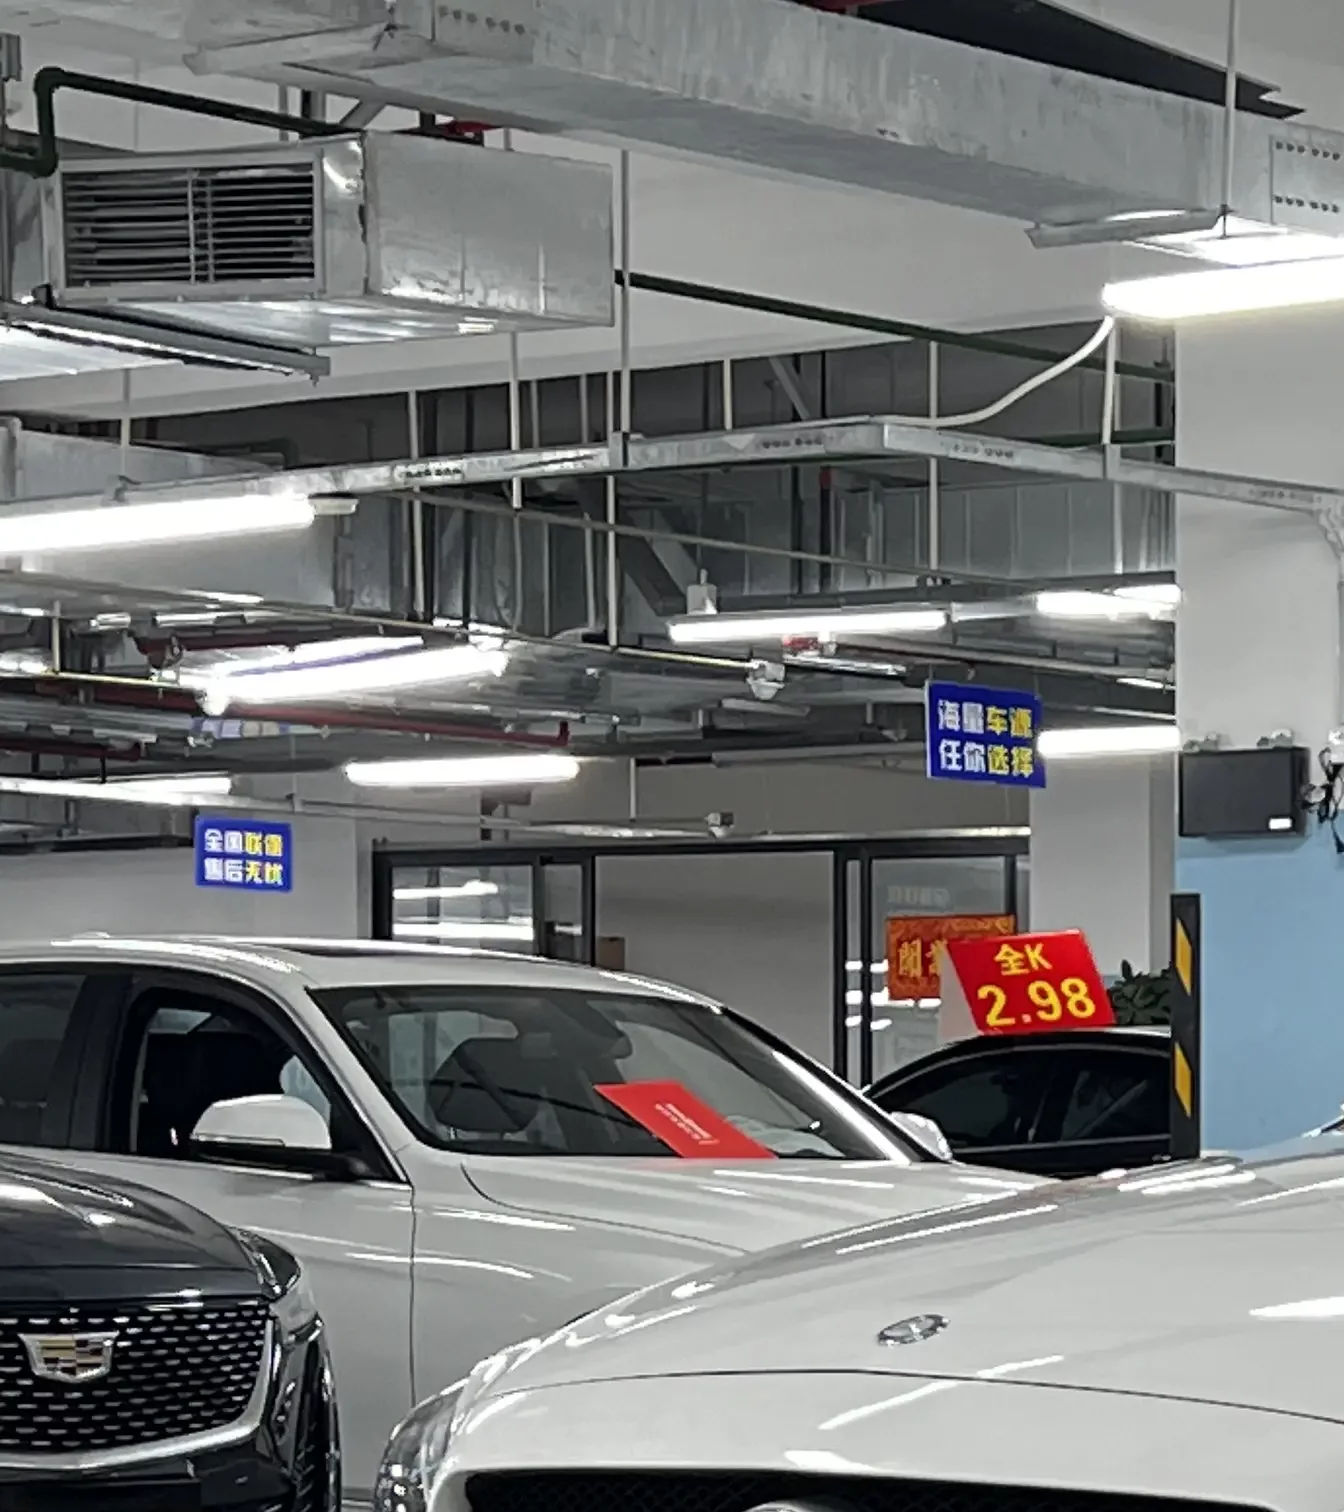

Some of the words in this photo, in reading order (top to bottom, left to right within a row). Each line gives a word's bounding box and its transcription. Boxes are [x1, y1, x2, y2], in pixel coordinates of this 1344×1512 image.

[938, 699, 1033, 738] 海量车源
[939, 738, 1034, 778] 任你选择
[994, 943, 1053, 976] 全K
[977, 977, 1096, 1027] 2.98
